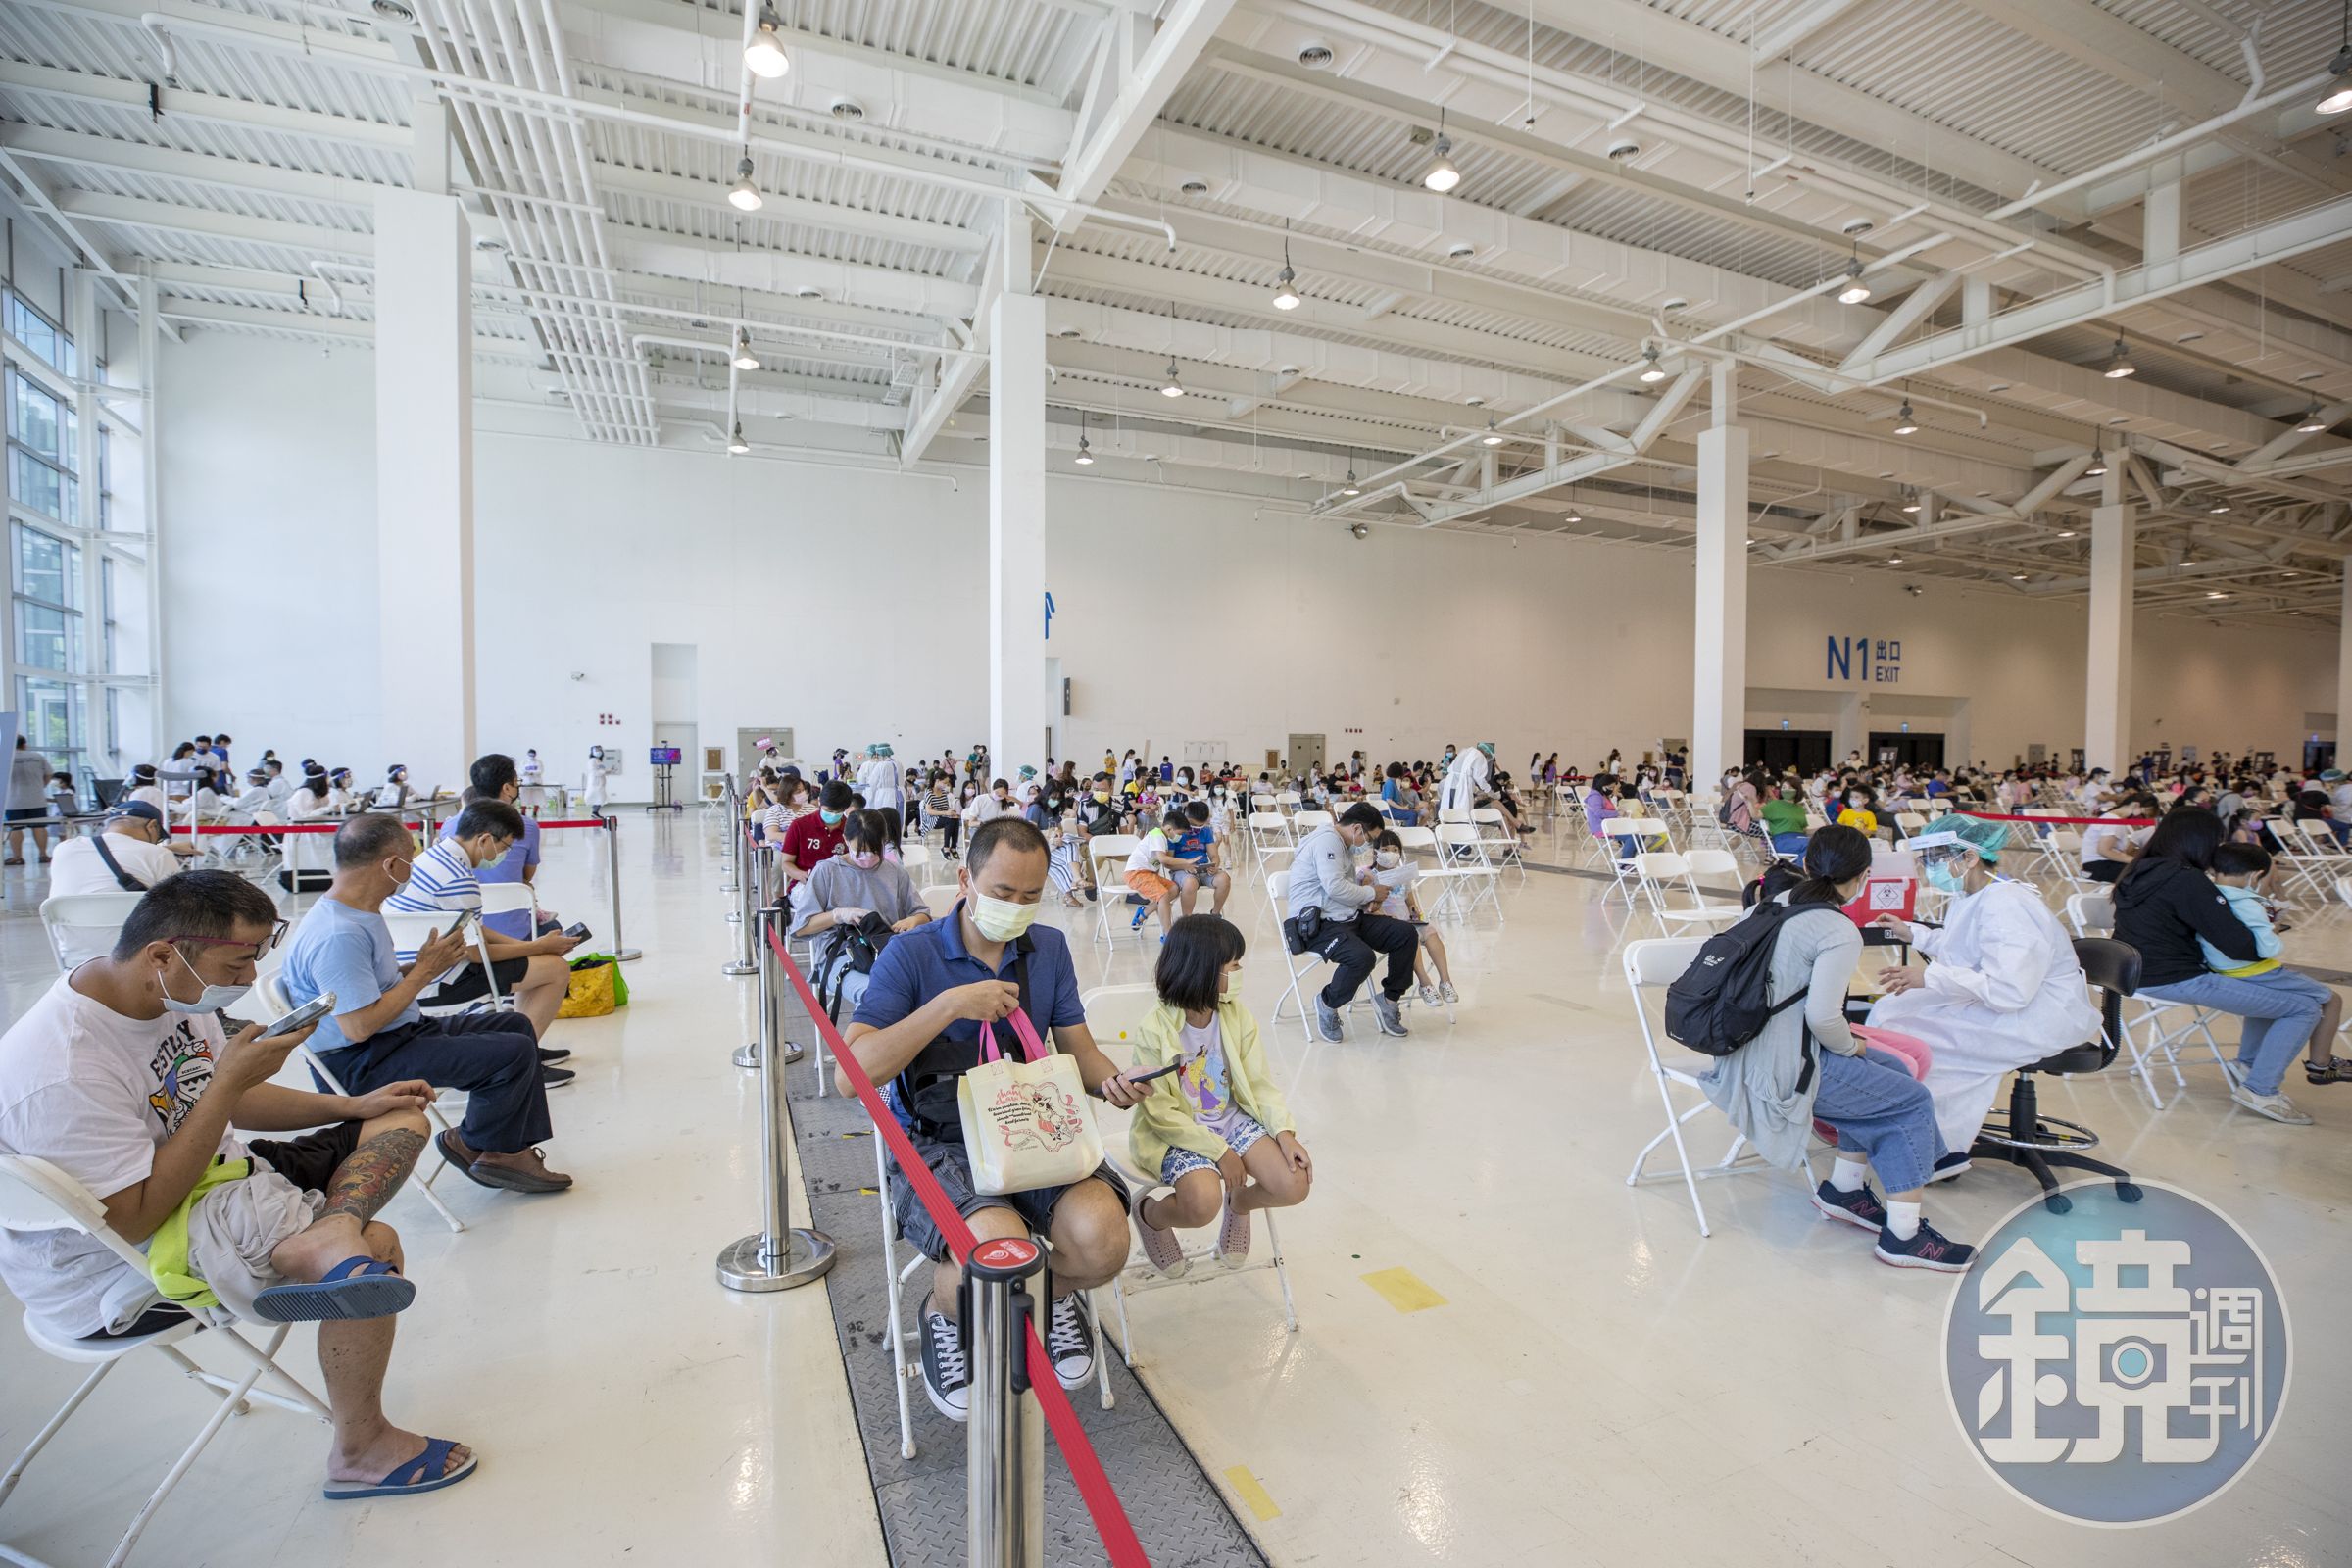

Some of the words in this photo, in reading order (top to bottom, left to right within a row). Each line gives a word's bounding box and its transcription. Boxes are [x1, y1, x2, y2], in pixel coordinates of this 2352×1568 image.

[1827, 635, 1869, 681] N1
[1876, 639, 1901, 661] 出口
[1876, 666, 1900, 682] EXIT
[807, 838, 821, 850] 73
[1917, 1242, 1945, 1261] N
